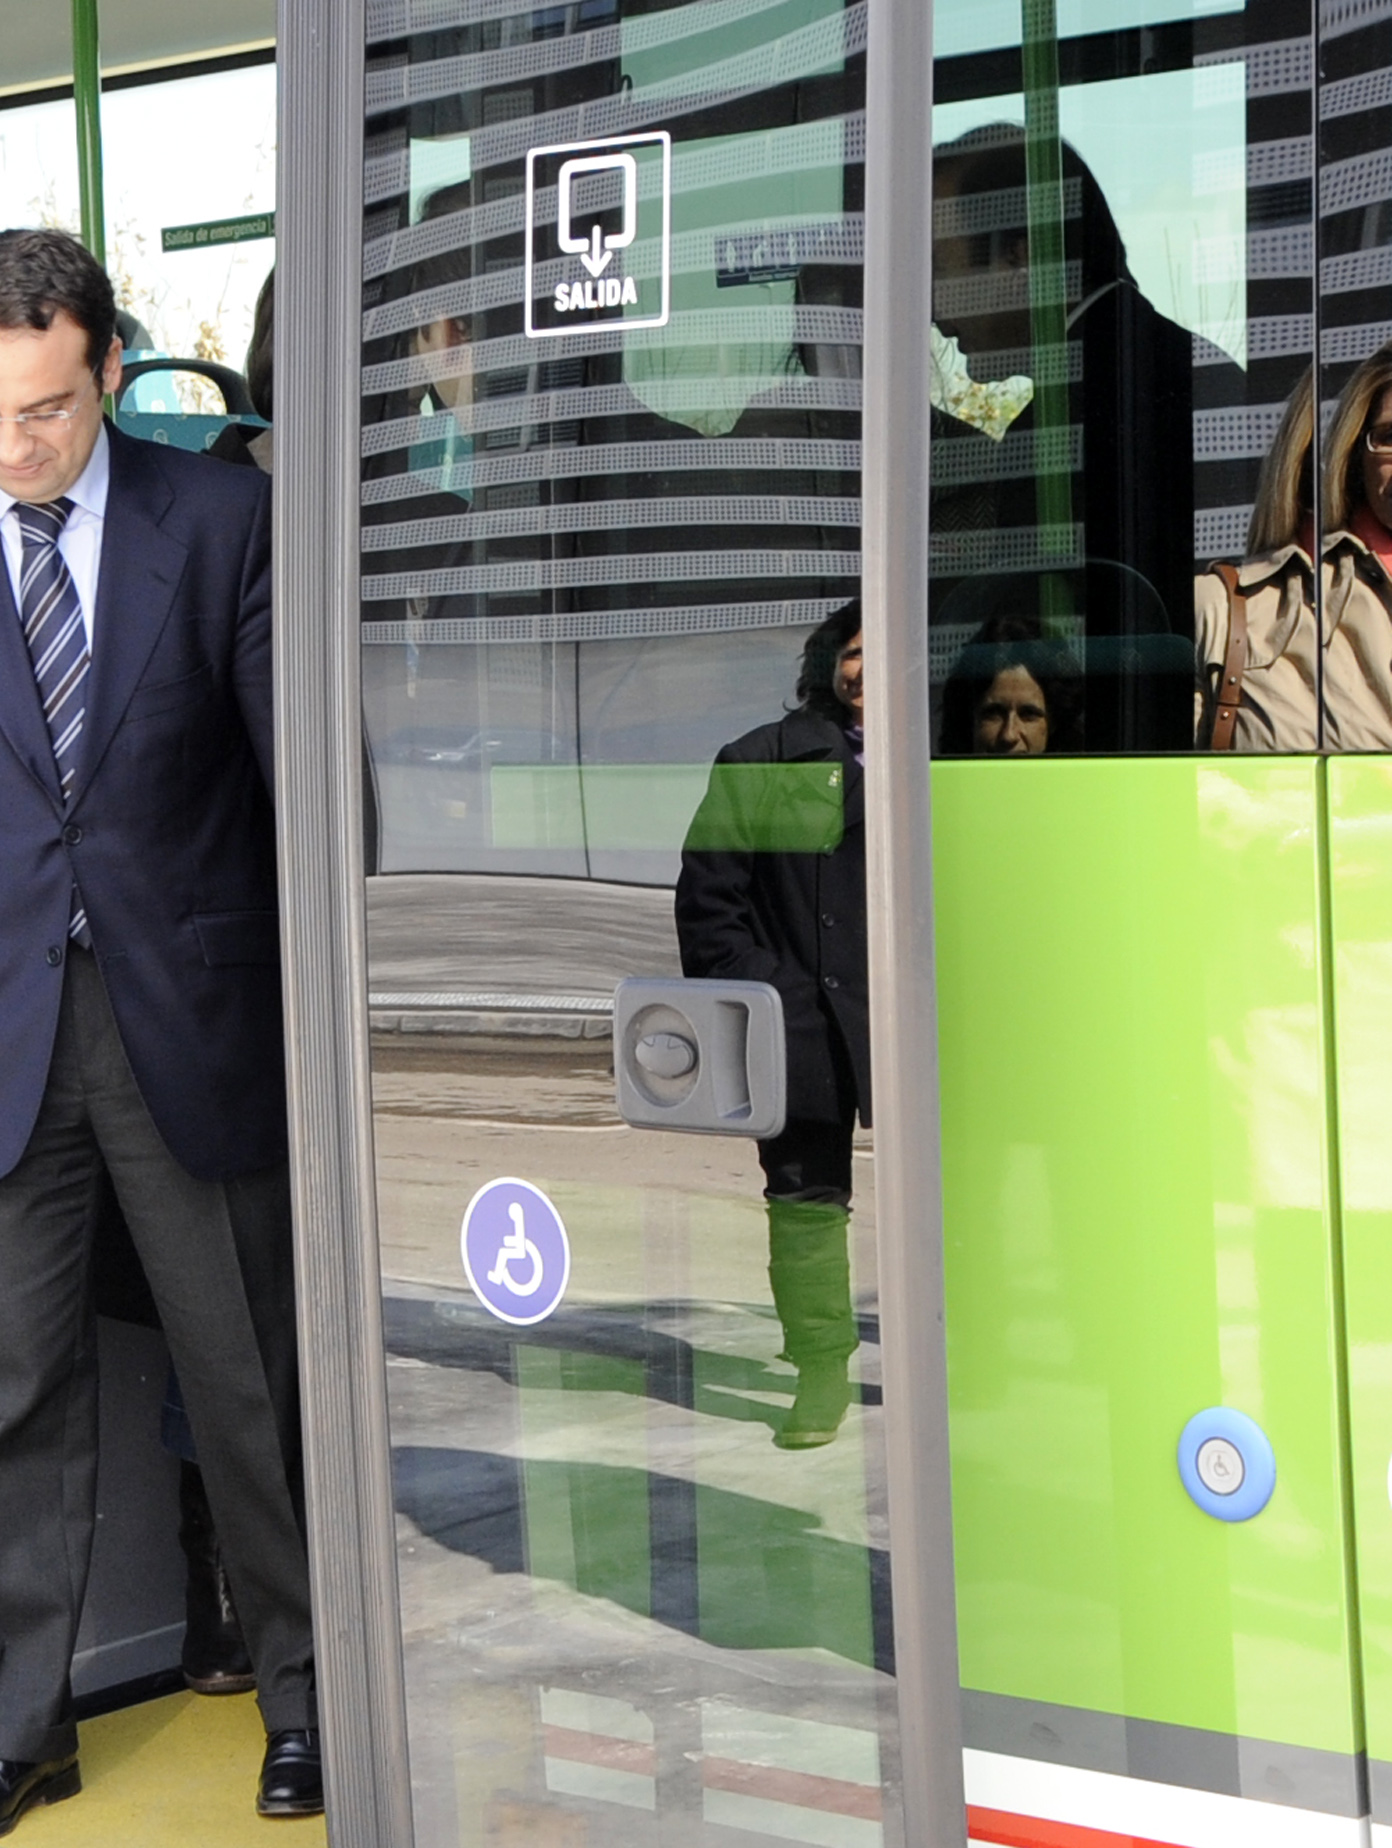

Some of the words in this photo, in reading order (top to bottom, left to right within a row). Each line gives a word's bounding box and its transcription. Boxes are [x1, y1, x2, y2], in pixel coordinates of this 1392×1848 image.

[165, 230, 194, 246] Salida
[196, 228, 208, 241] de
[210, 220, 266, 239] emergencia
[554, 277, 637, 312] SALIDA
